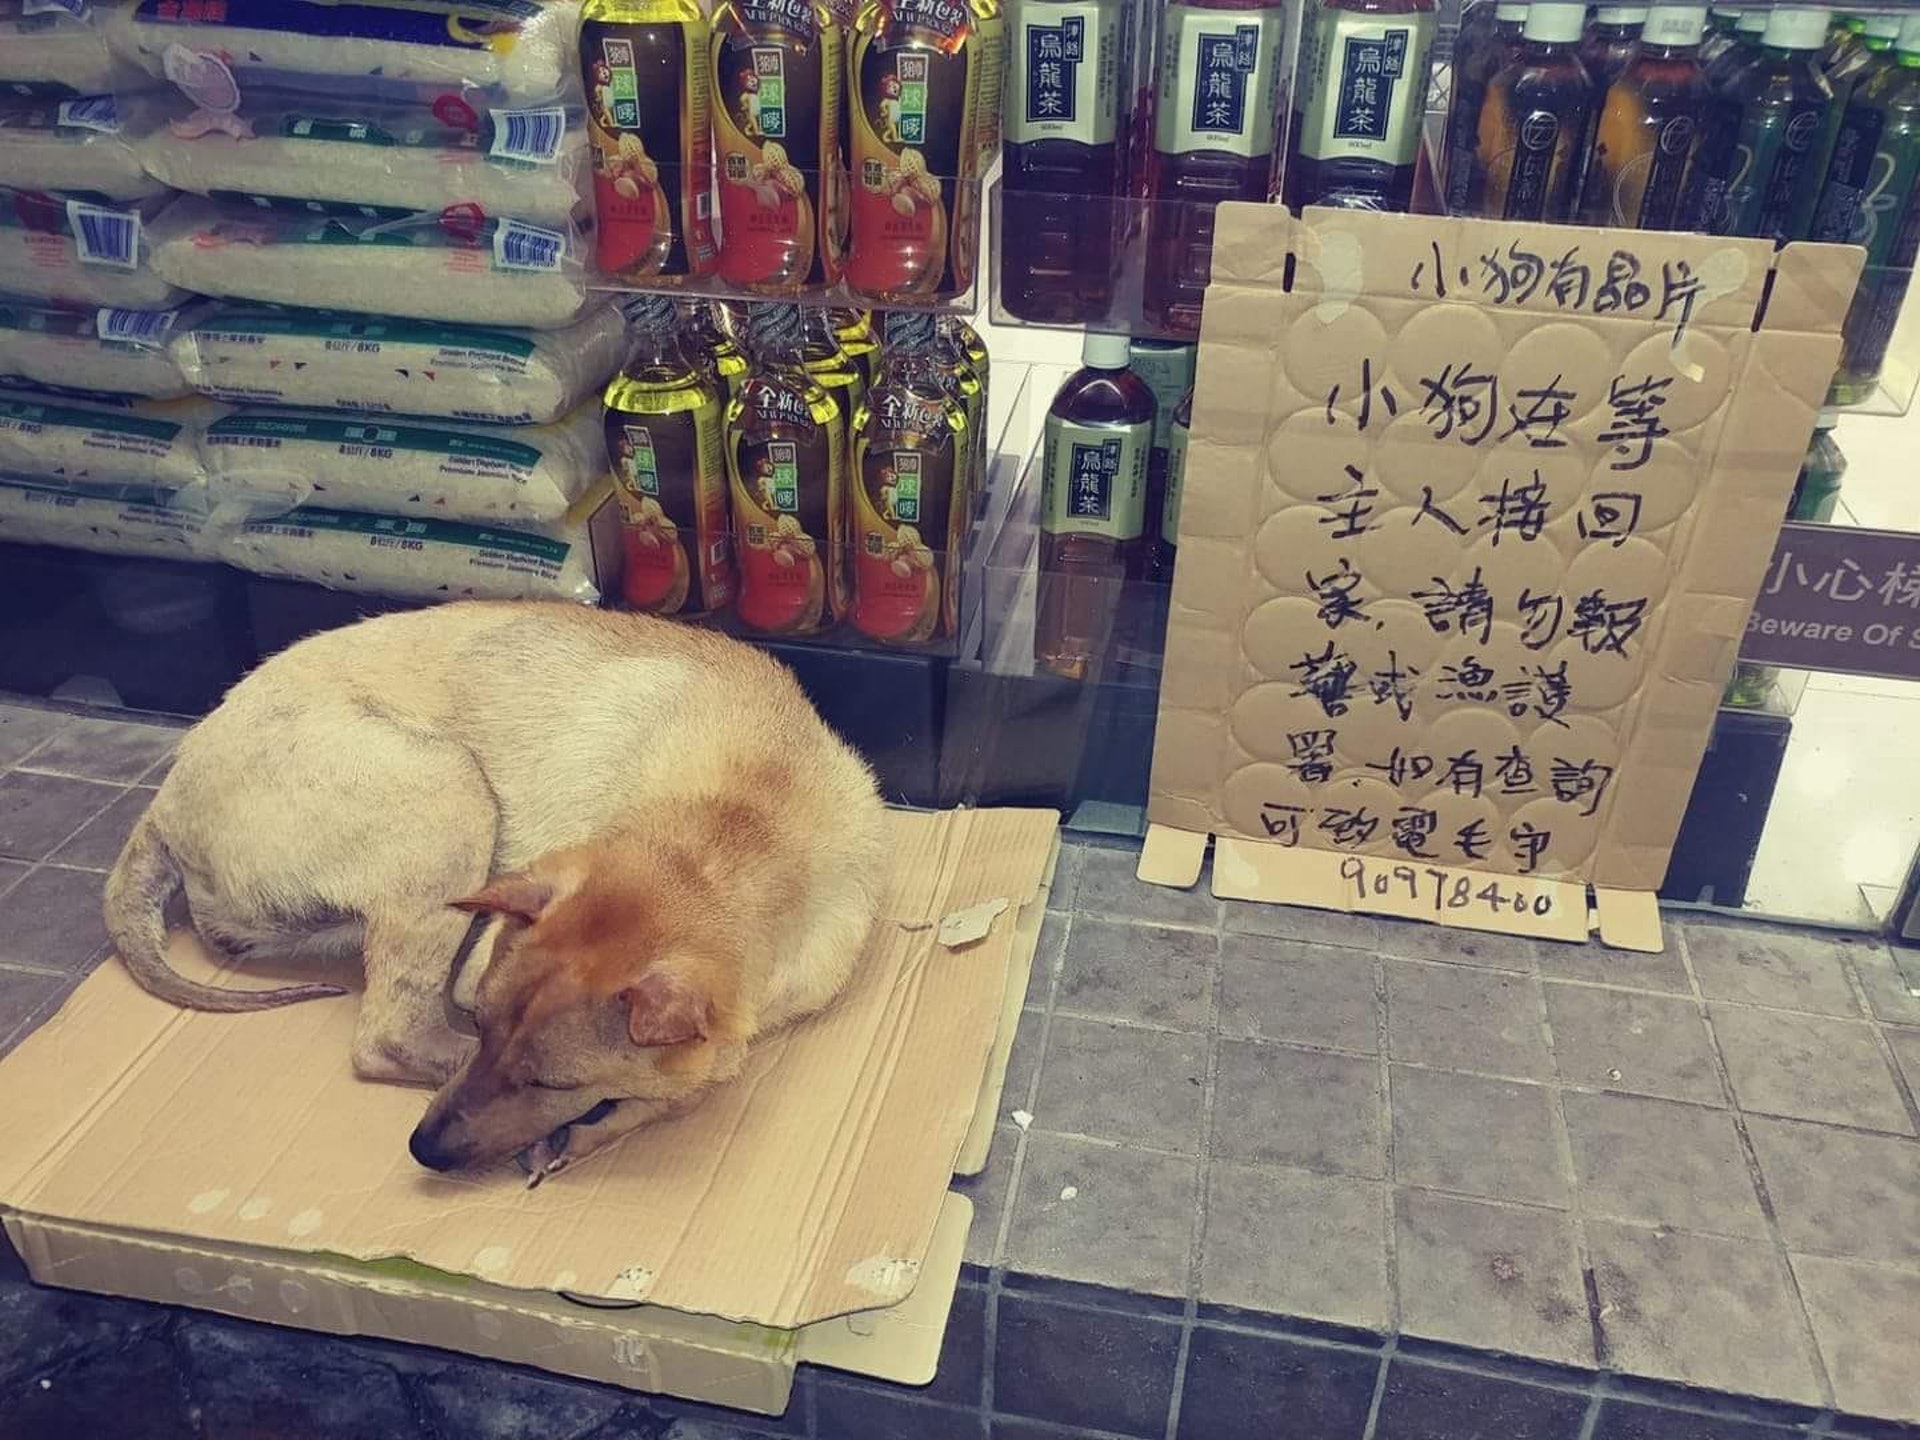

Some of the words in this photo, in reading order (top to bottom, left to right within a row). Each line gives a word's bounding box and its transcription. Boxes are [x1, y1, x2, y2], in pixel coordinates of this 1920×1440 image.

[1038, 34, 1063, 115] 烏龍茶
[1205, 42, 1233, 126] 烏龍茶
[1347, 47, 1381, 132] 烏龍茶
[1411, 238, 1706, 349] 小狗有晶片
[1327, 358, 1675, 471] 小狗在等
[1078, 450, 1101, 514] 烏龍茶
[1316, 464, 1643, 548] 主人接回
[1747, 611, 1853, 642] Beware
[1863, 624, 1904, 647] Of
[1340, 856, 1552, 917] 90978400
